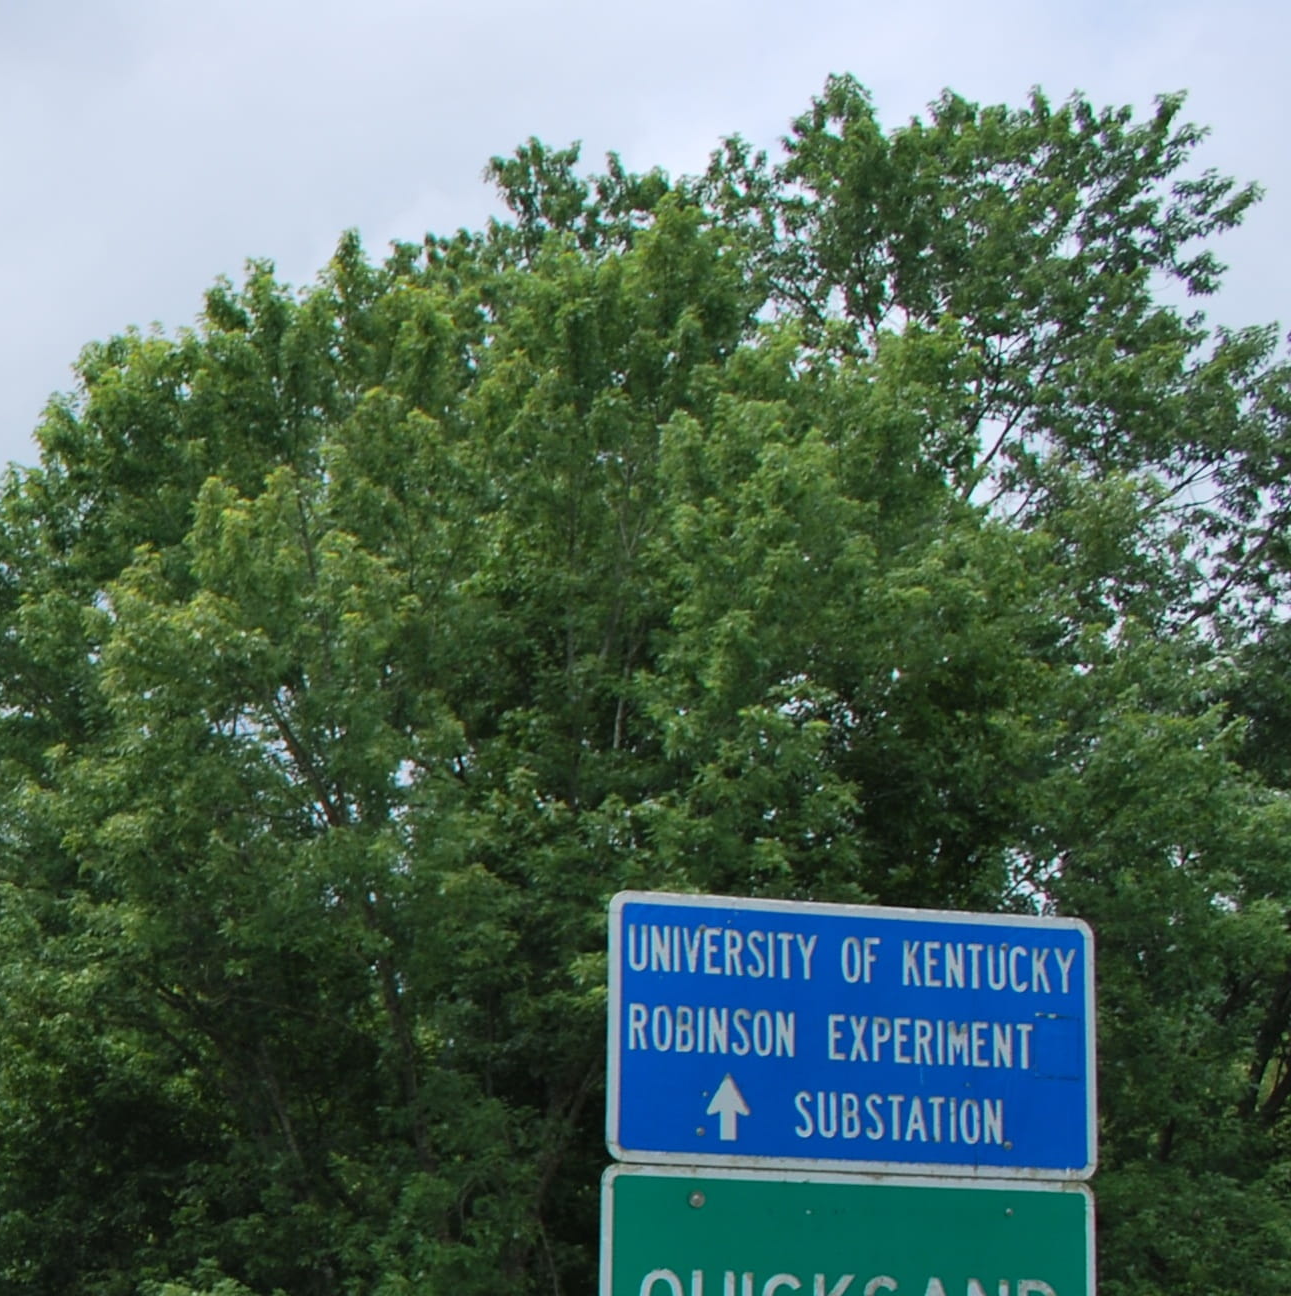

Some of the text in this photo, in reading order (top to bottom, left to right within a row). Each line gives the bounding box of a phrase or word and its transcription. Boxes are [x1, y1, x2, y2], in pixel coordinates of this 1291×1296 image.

[627, 923, 1076, 994] UNIVERSITY OF KENTUCKY
[628, 1003, 1034, 1070] ROBINSON EXPERIMENT
[794, 1091, 1005, 1146] SUBSTATION
